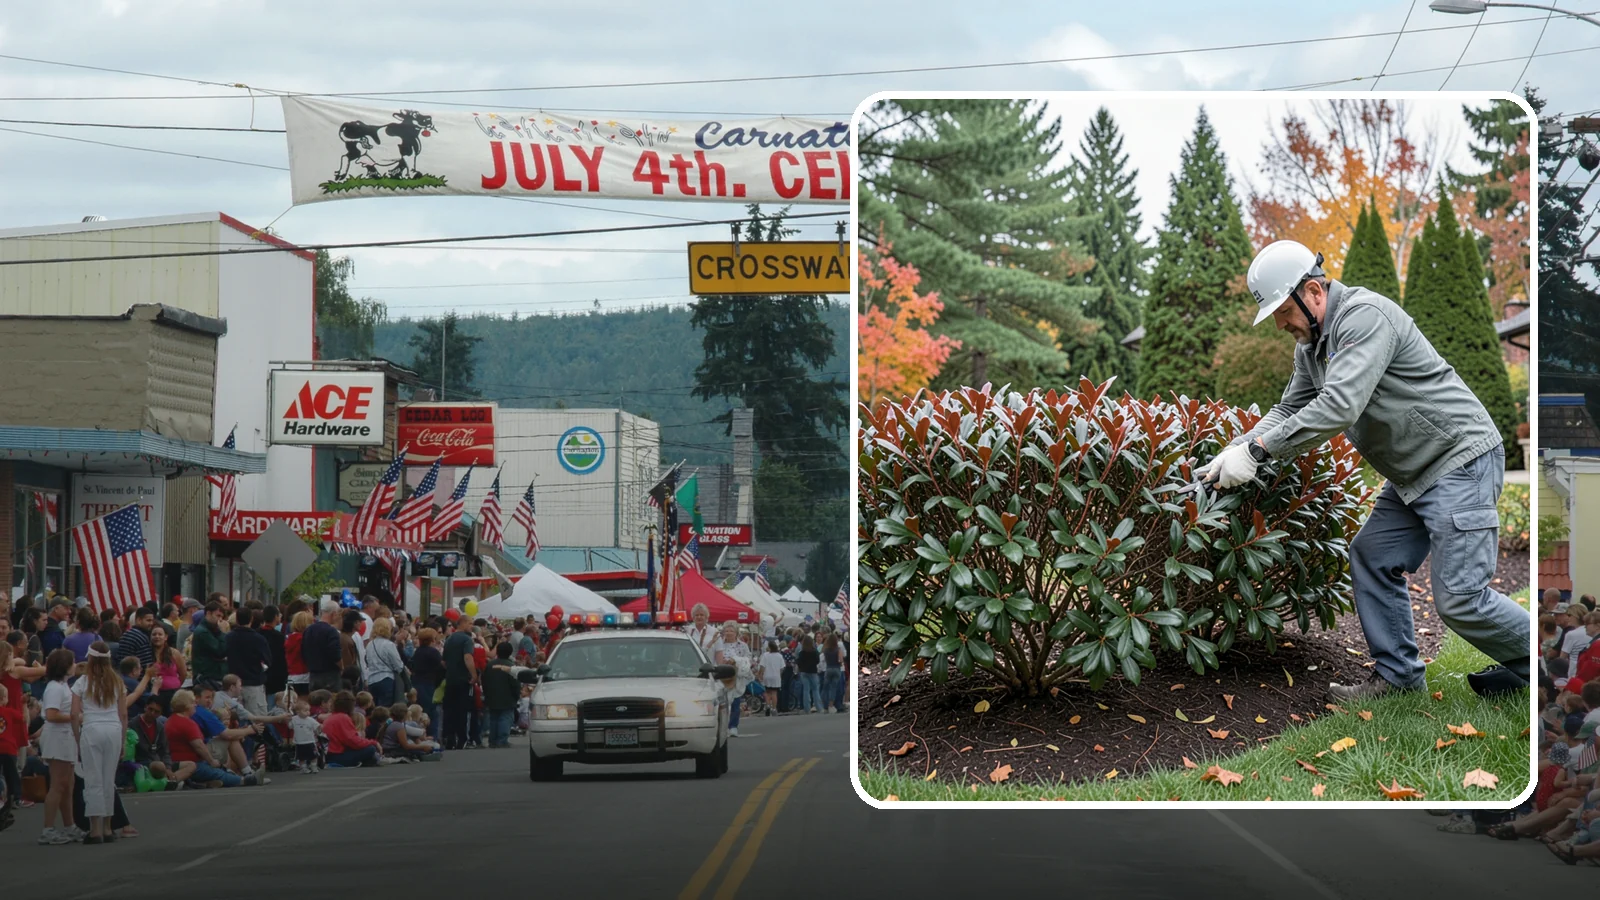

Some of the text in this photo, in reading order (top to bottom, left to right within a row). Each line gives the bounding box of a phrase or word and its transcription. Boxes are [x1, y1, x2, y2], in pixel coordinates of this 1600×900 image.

[481, 141, 604, 192] JULY
[632, 150, 746, 198] 4th.
[697, 254, 850, 280] CROSSWA
[283, 380, 373, 420] ACE
[406, 409, 452, 422] CEDAR
[284, 421, 371, 436] Hardware
[353, 467, 386, 479] Simpl
[96, 485, 124, 495] Vincent
[126, 486, 136, 495] de
[137, 486, 155, 495] Paul
[81, 503, 154, 521] THT
[213, 516, 331, 536] HARDARE
[688, 526, 741, 535] CRNATION
[699, 535, 730, 543] GLASS
